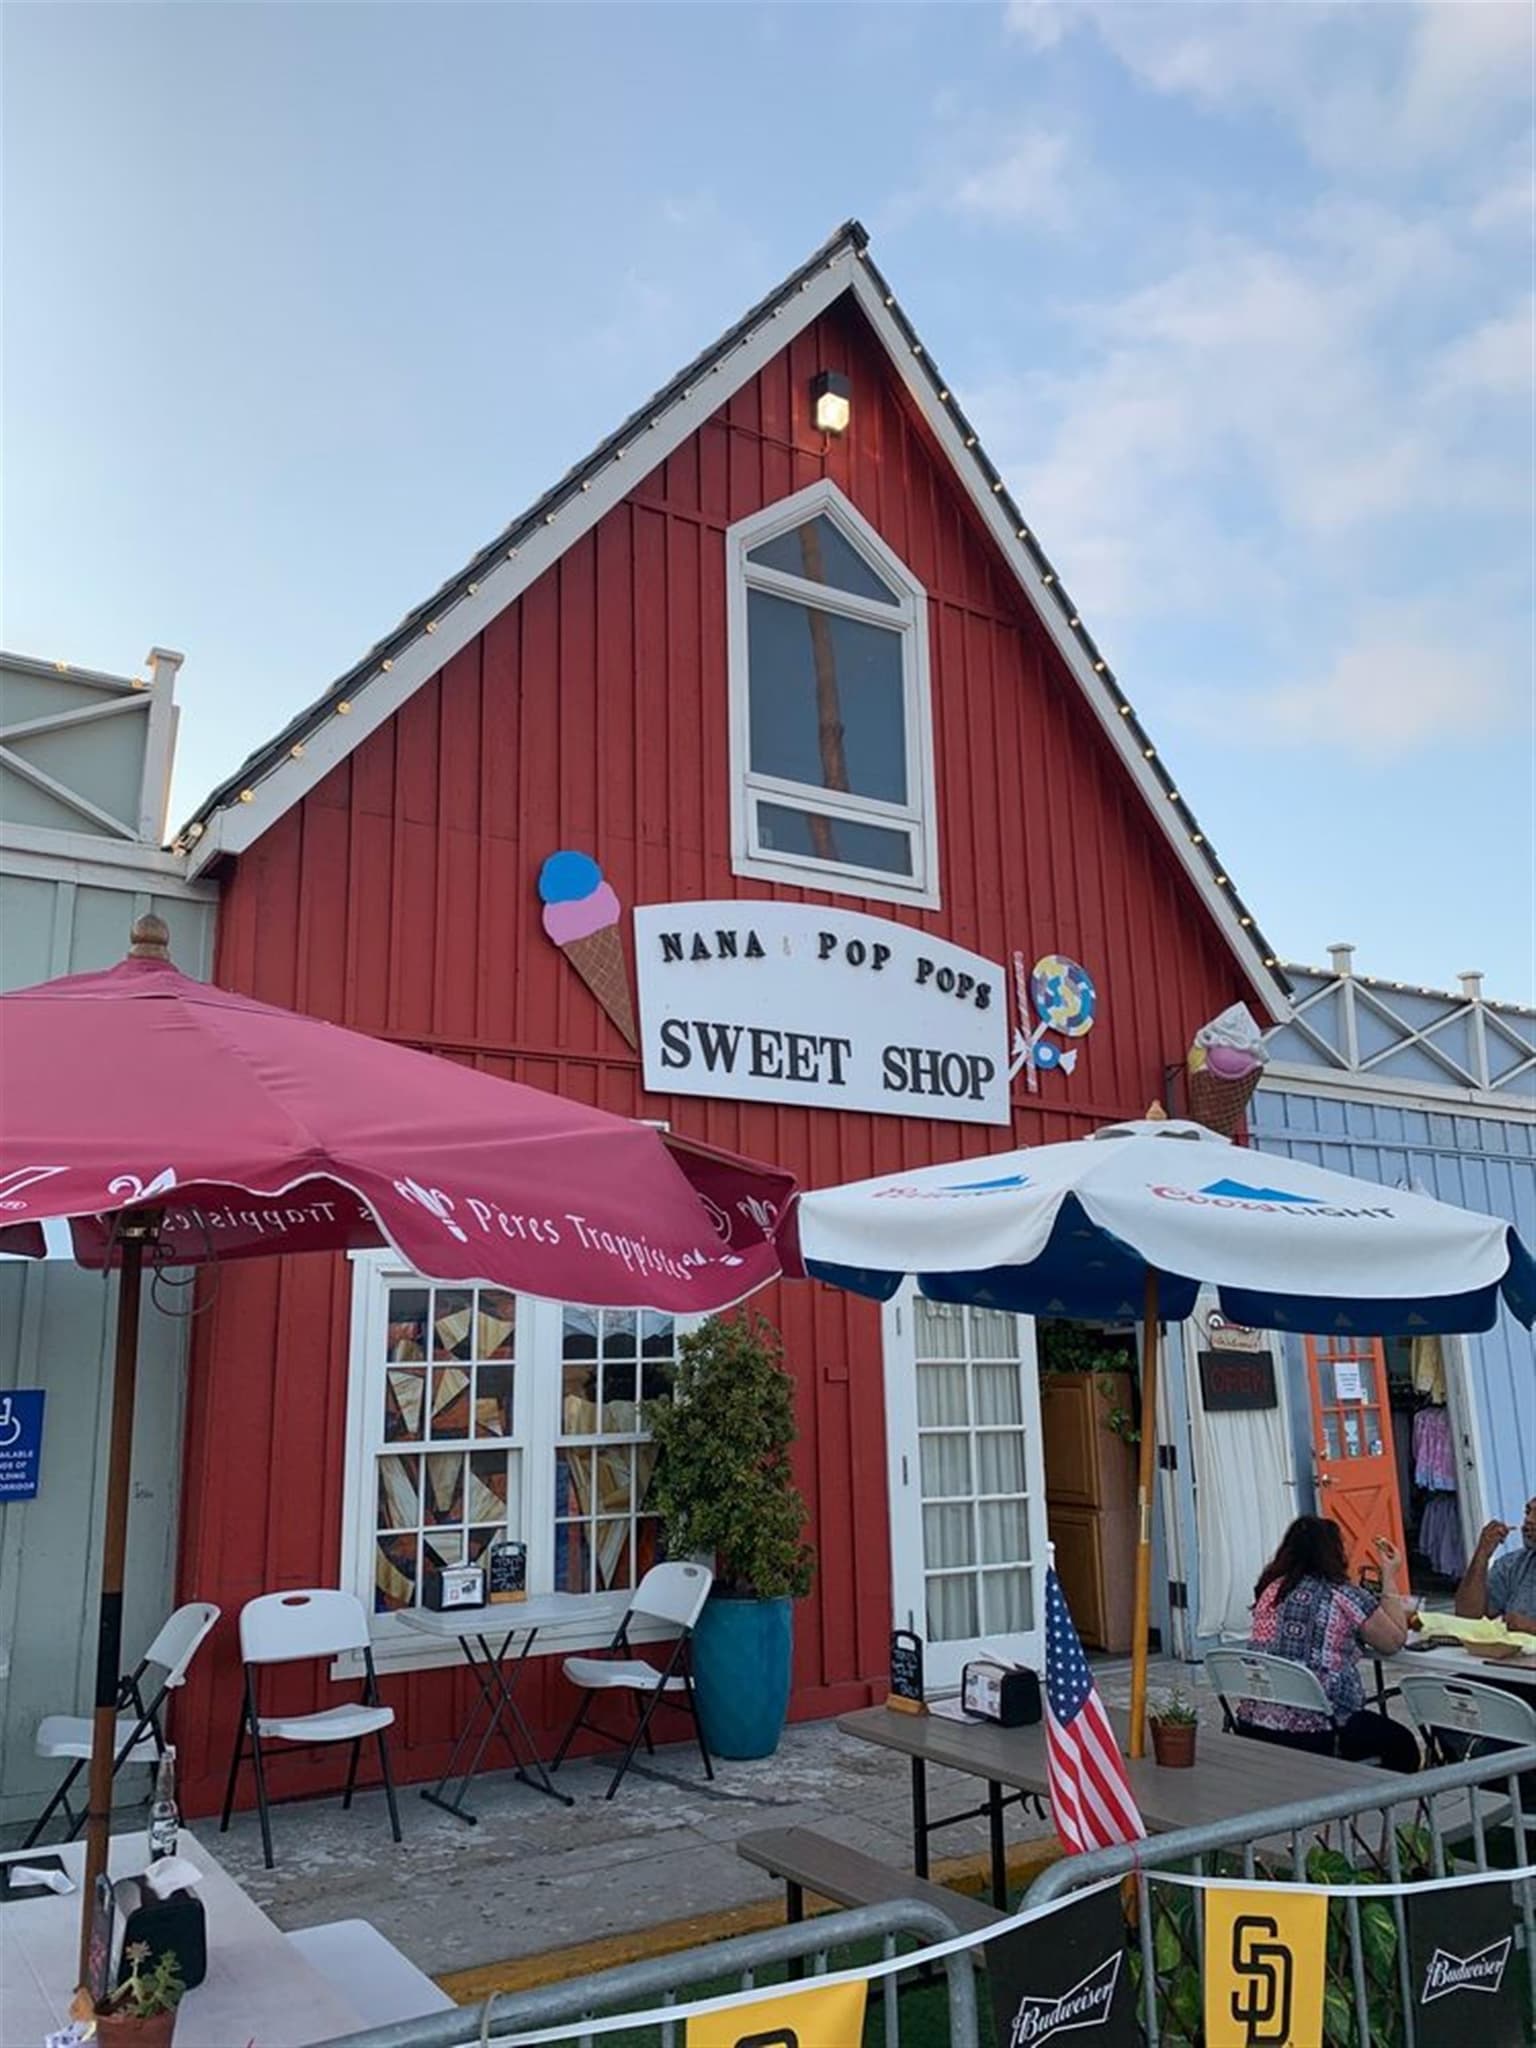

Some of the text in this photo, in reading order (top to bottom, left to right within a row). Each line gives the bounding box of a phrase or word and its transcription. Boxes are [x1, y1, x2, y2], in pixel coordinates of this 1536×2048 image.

[658, 930, 992, 1010] NANA POP POPS
[660, 1018, 996, 1101] SWEET SHOP
[1281, 1205, 1395, 1219] LIGHT
[564, 1214, 692, 1280] Trappistes
[1231, 1915, 1292, 2047] SD
[1426, 1956, 1503, 1987] Budweiser
[1011, 1982, 1113, 2045] Budweiser
